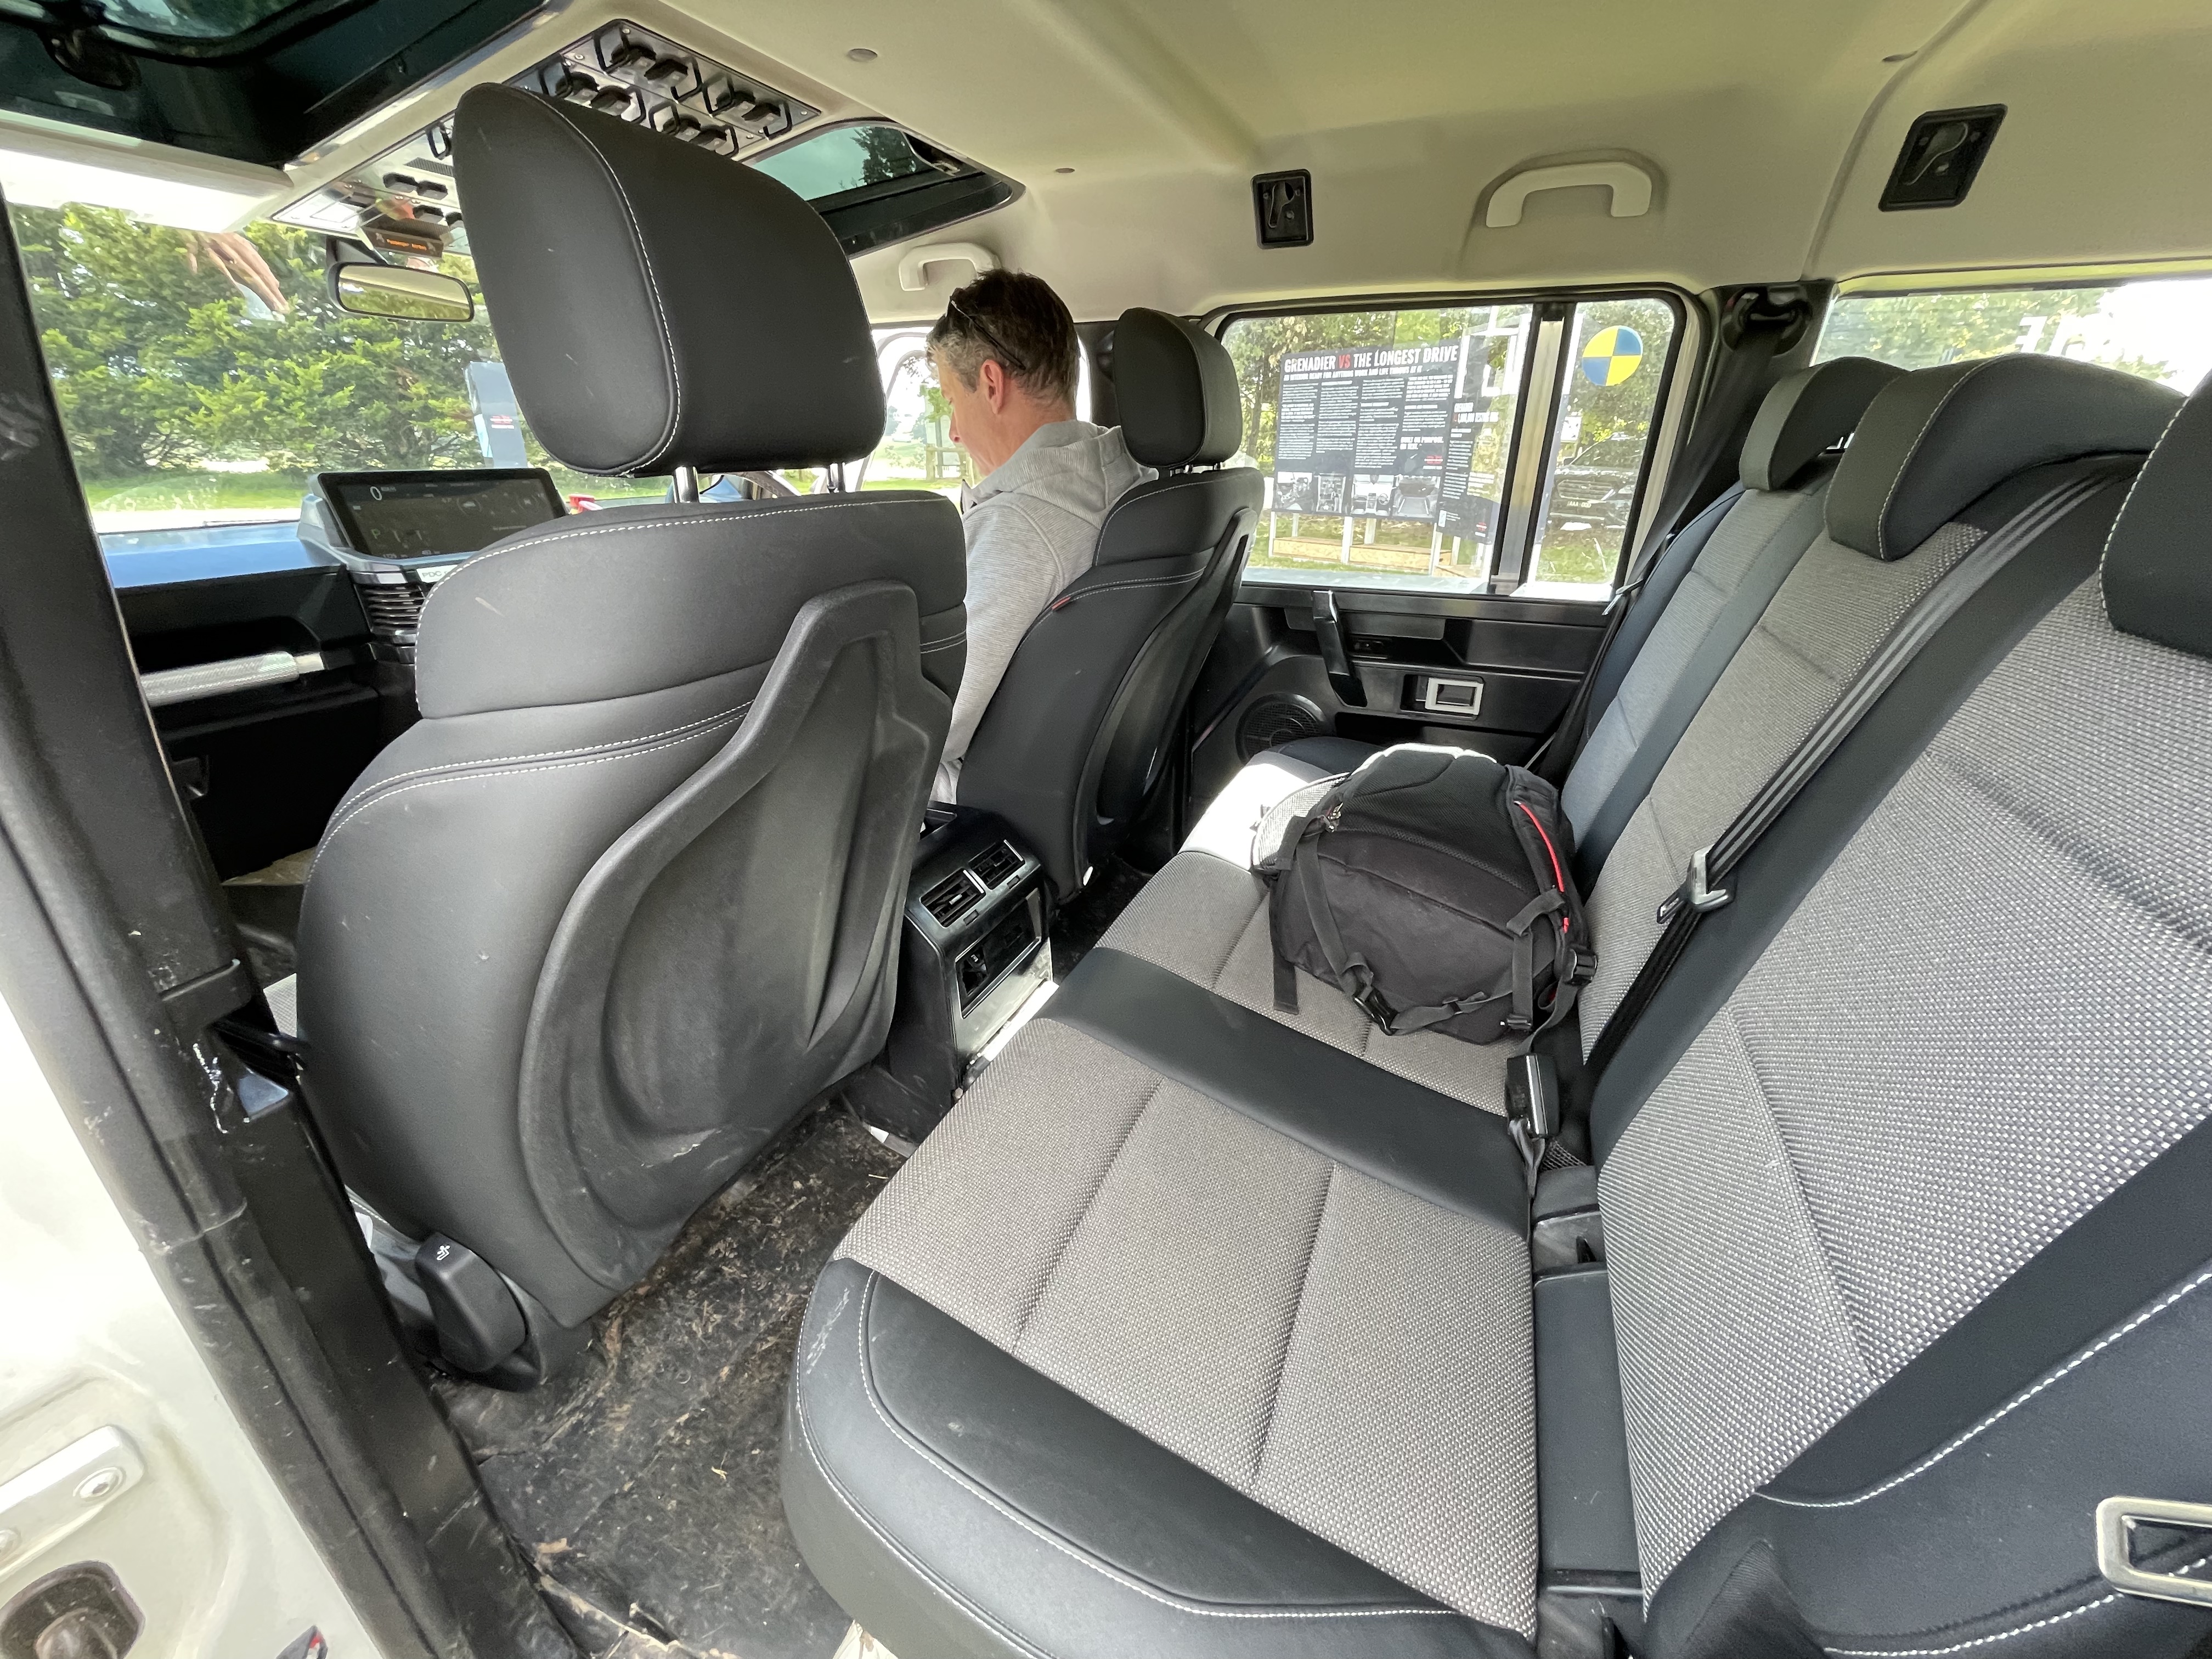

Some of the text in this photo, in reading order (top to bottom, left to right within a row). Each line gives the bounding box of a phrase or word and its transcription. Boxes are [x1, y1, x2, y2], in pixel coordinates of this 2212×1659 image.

[1284, 345, 1459, 373] GRENADIER VS THE LONGEST DRIVE
[1379, 367, 1389, 375] LIFE
